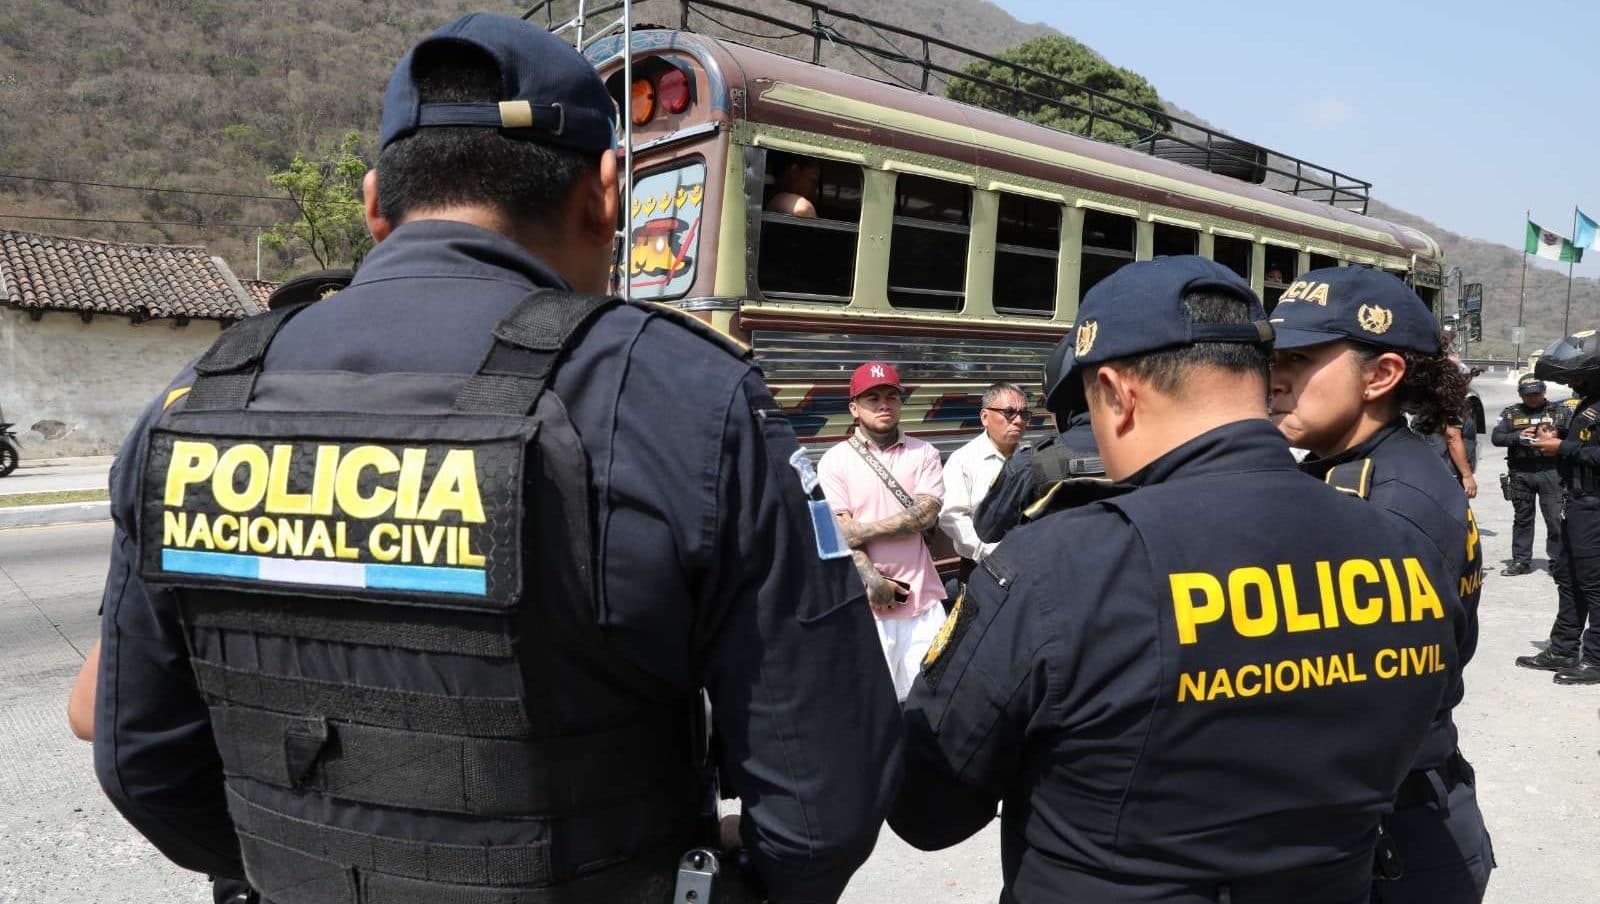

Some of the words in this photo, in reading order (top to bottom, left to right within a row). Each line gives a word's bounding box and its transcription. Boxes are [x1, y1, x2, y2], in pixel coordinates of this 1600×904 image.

[163, 440, 487, 524] POLICIA
[163, 510, 360, 560] NACIONAL
[368, 522, 487, 567] CIVIL
[1168, 557, 1445, 646] POLICIA
[1176, 652, 1368, 703] NACIONAL
[1374, 643, 1446, 682] CIVIL
